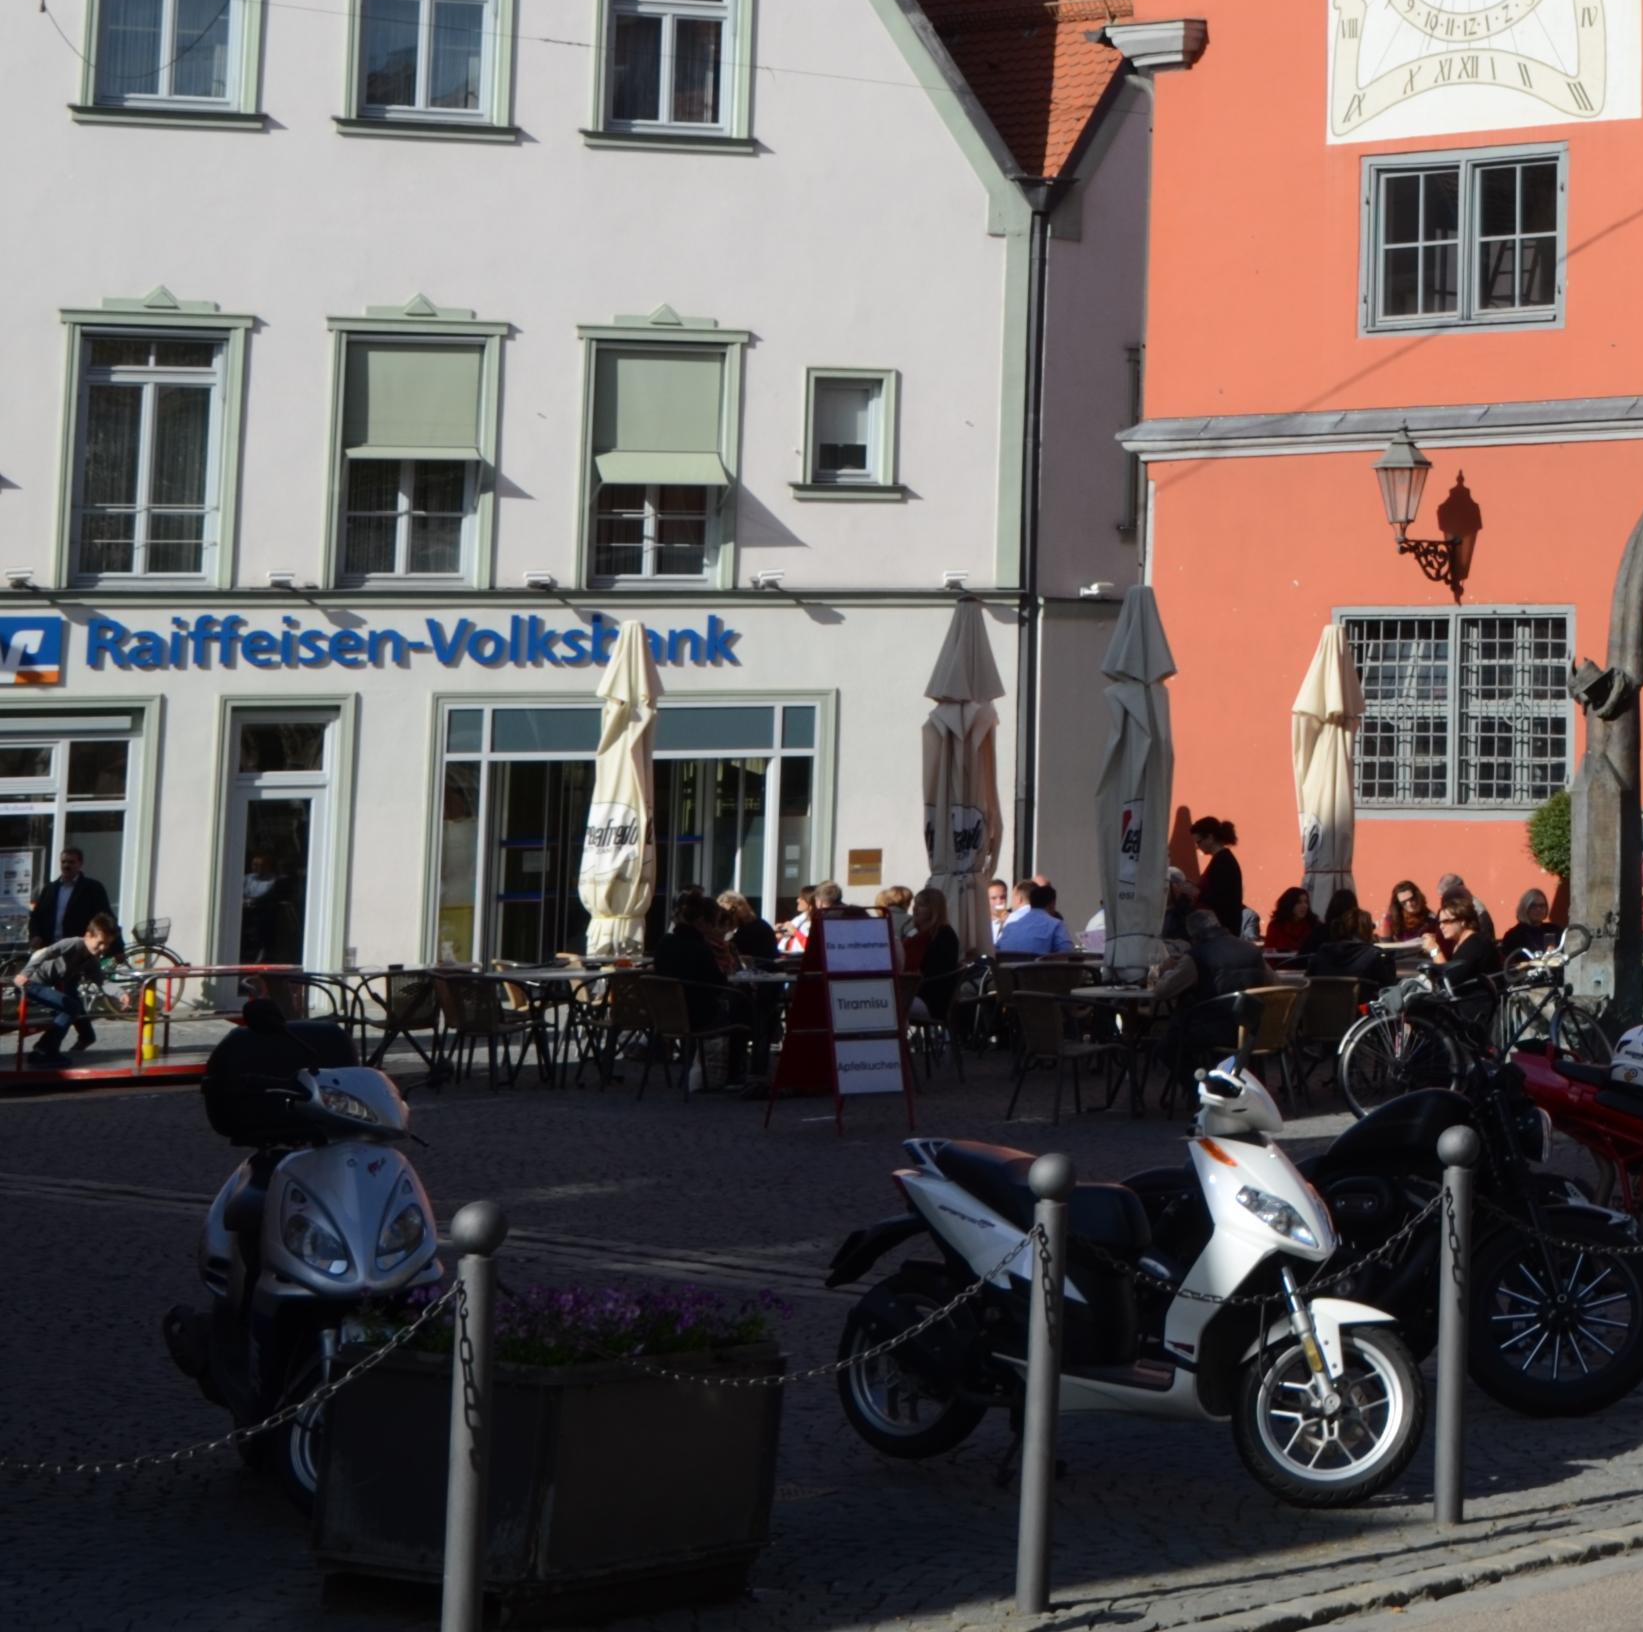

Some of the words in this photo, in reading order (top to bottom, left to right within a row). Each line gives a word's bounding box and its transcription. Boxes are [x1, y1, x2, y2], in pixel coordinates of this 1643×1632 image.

[1341, 18, 1358, 39] VIII
[1424, 10, 1439, 31] 10
[1445, 17, 1455, 36] 11
[1581, 5, 1598, 28] IV
[1434, 57, 1453, 83] XI
[1458, 55, 1479, 79] XII
[1490, 56, 1497, 80] I
[1517, 61, 1533, 88] II
[1403, 65, 1422, 95] X
[1342, 92, 1366, 123] IX
[1566, 81, 1595, 112] III
[847, 941, 889, 950] mitnehmen
[836, 996, 889, 1011] Tiramisu
[837, 1059, 899, 1073] Apfelkuchen
